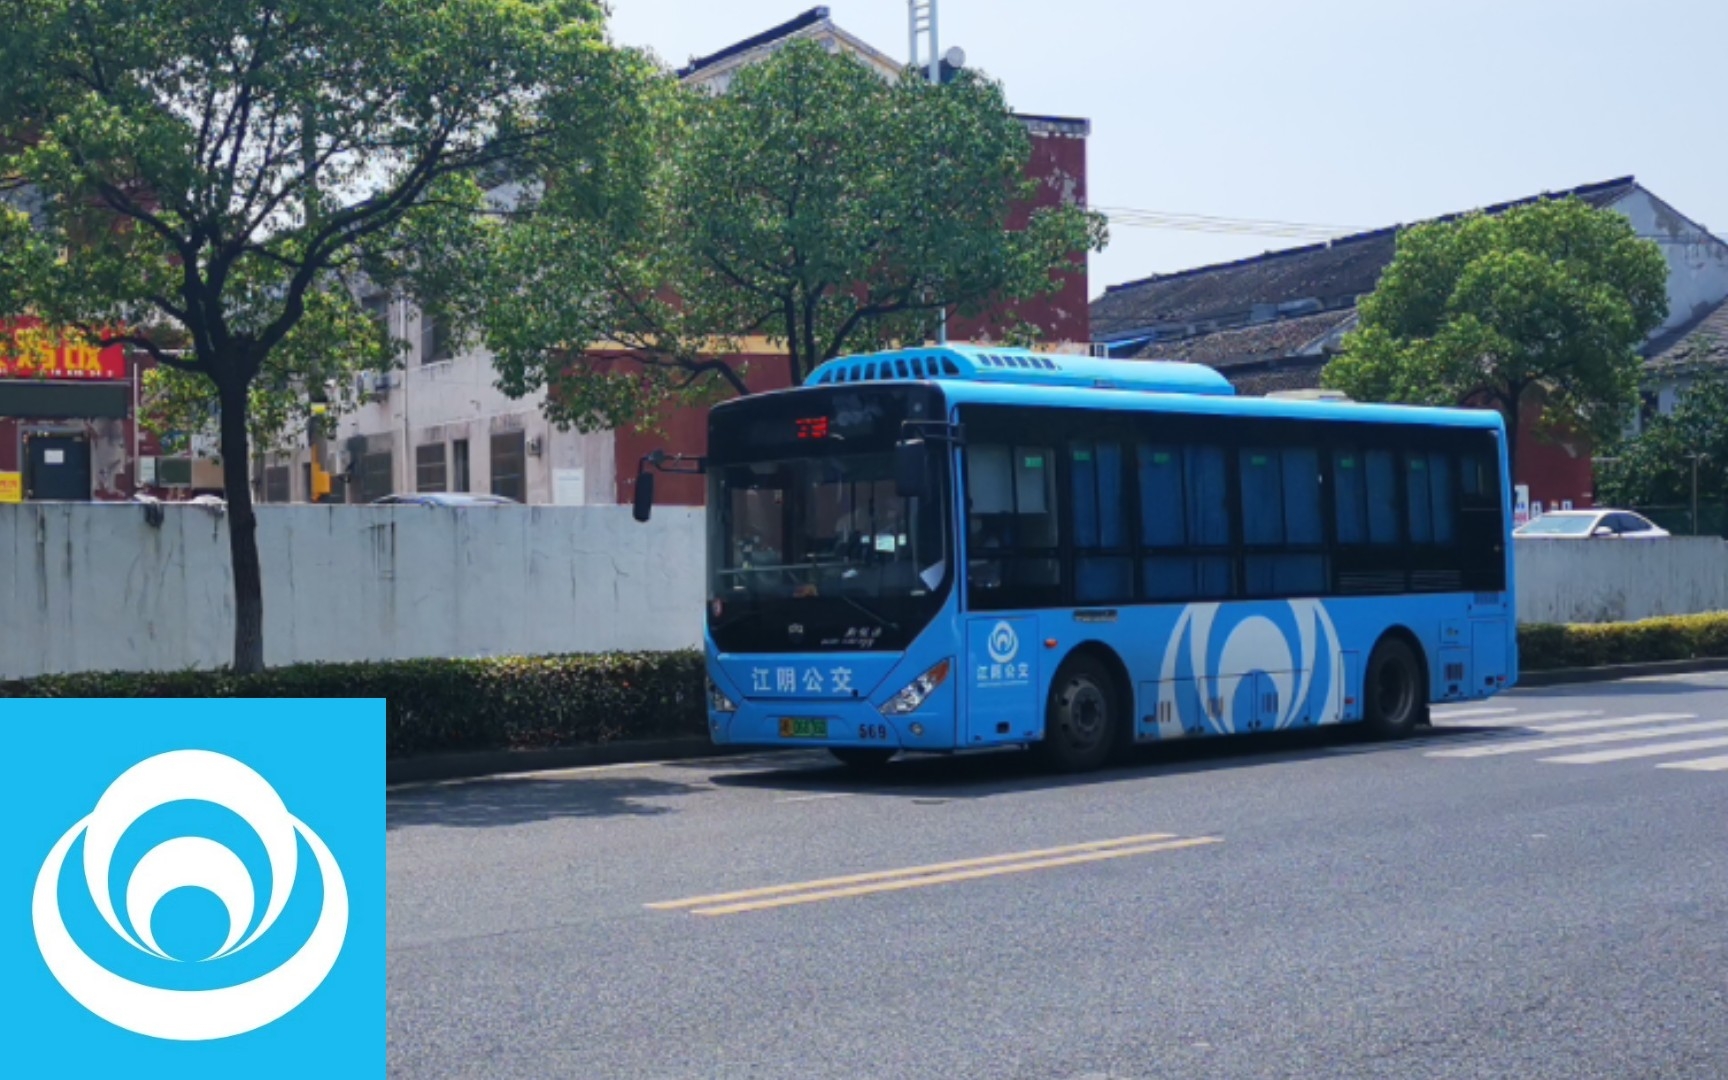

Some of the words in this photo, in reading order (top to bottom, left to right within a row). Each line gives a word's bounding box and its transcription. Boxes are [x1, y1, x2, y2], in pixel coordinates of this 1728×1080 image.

[751, 666, 853, 693] 江阴公交
[977, 662, 1029, 681] 江阴公交
[858, 723, 888, 739] 569
